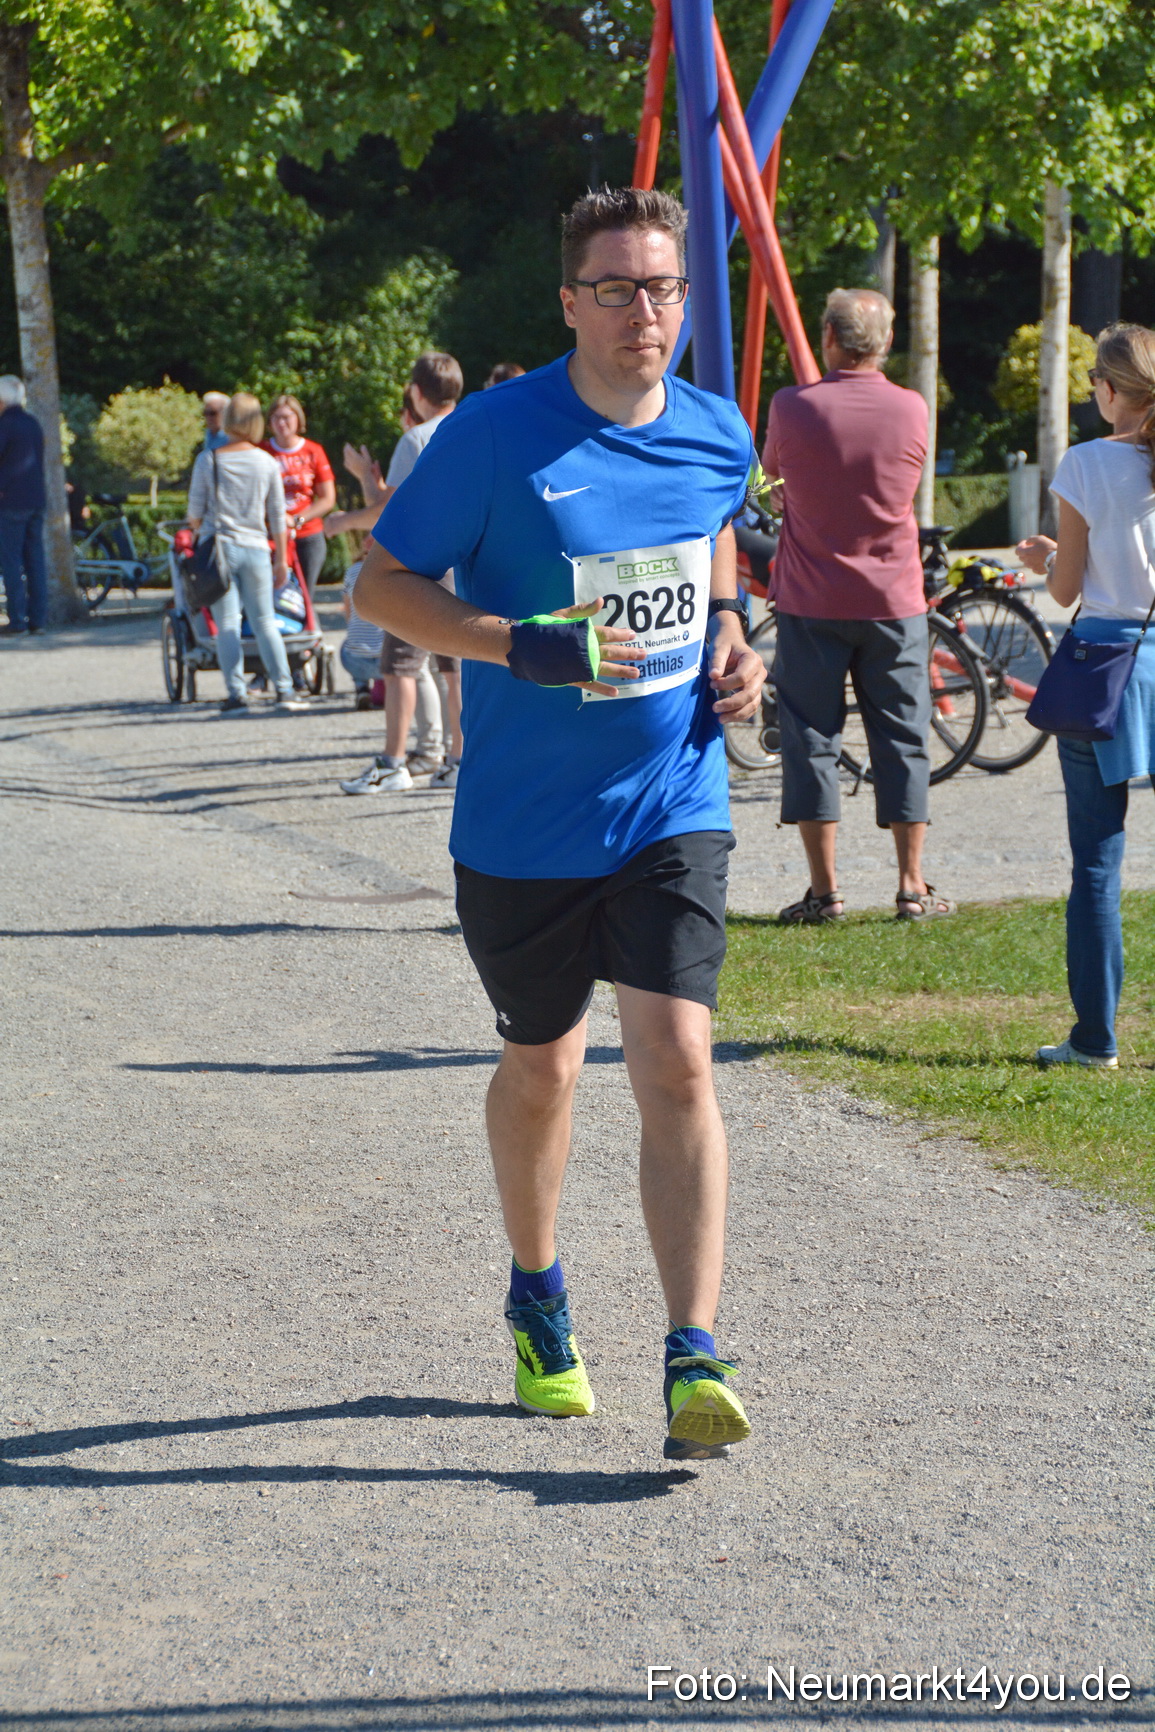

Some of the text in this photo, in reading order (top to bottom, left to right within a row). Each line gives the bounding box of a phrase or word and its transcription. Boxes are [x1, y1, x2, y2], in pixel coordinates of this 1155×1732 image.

[617, 557, 678, 579] BOCK
[602, 582, 695, 633] 2628
[617, 635, 680, 649] RTL Neumarkt
